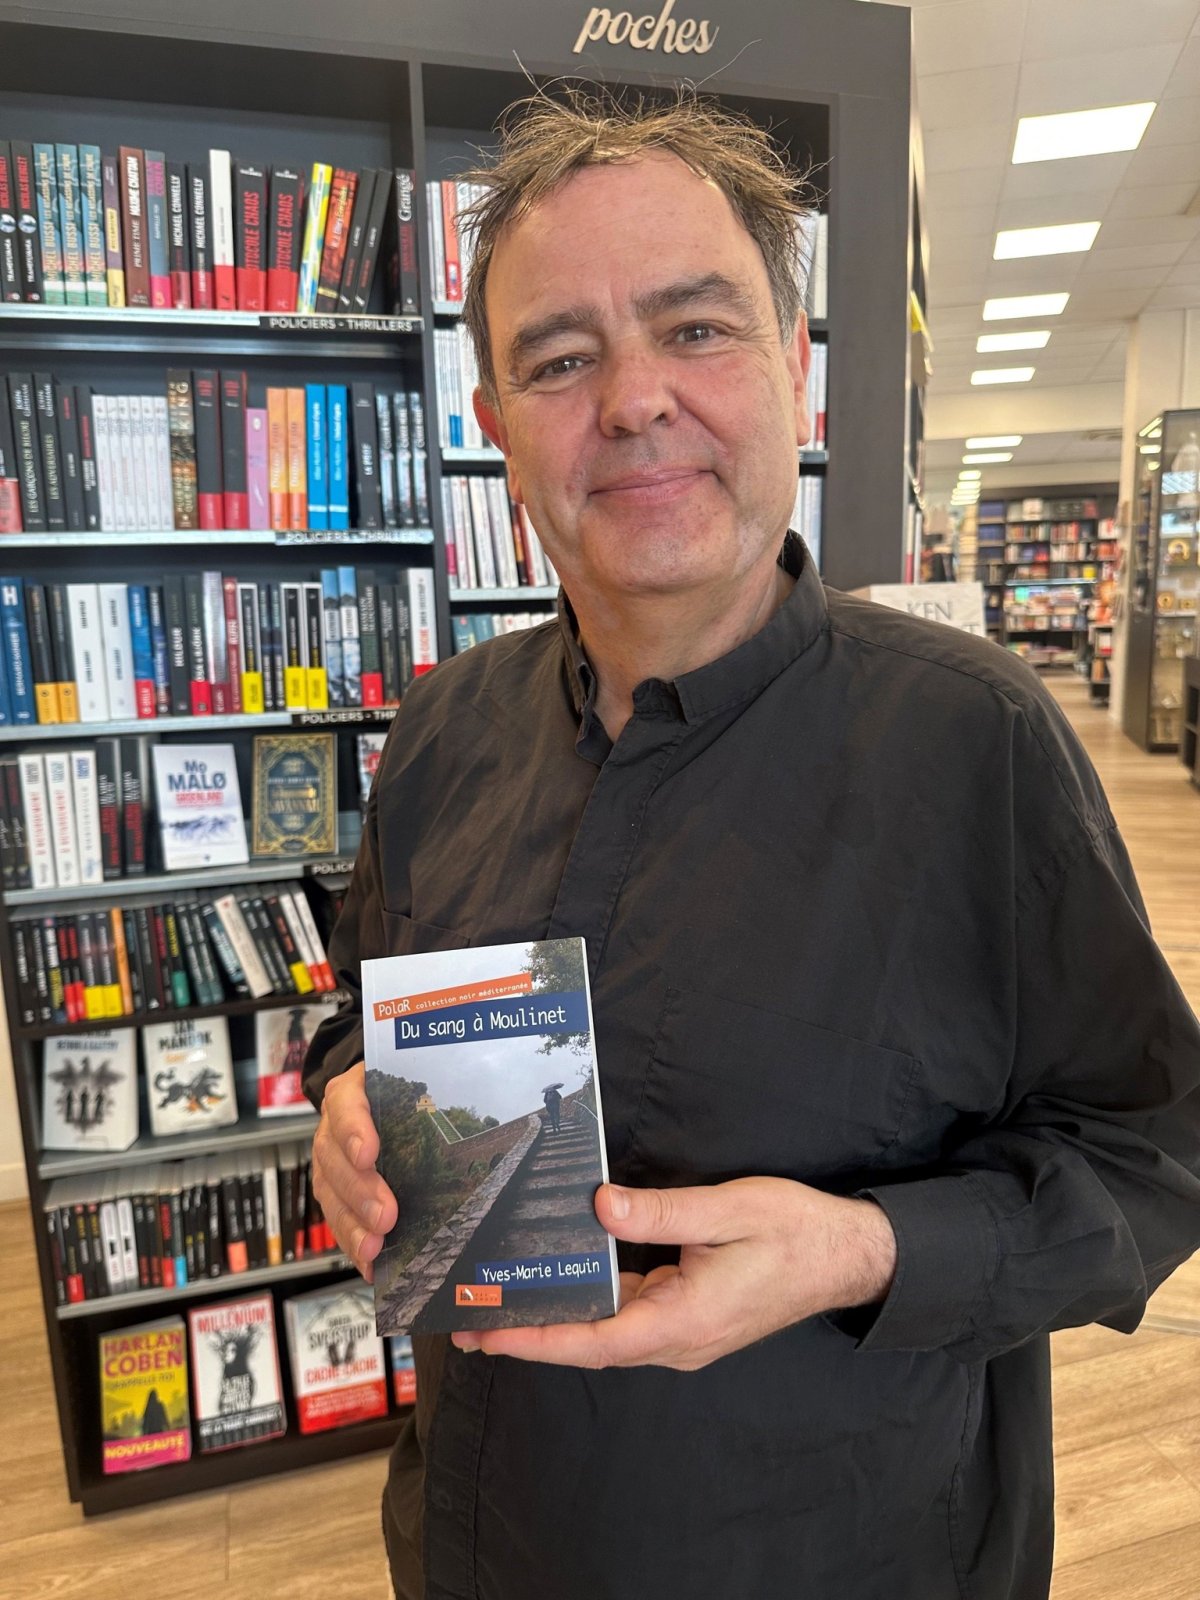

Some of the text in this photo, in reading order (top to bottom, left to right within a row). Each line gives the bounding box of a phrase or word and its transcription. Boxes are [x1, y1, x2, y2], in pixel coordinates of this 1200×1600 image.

[572, 0, 719, 54] poches
[127, 156, 140, 189] CHATTAM
[170, 175, 184, 246] MICHAEL CONNELLY
[193, 178, 205, 215] CONNELLY
[243, 191, 260, 225] CHAOS
[277, 193, 294, 227] CHAOS
[396, 173, 414, 222] Grangé
[131, 220, 142, 267] PRIME TIME
[195, 216, 206, 248] MICHAEL
[44, 222, 57, 282] MICHEL BUSSI
[65, 222, 78, 282] MICHEL BUSSI
[86, 222, 99, 282] MICHEL BUSSI
[269, 318, 337, 330] POLICIERS
[347, 319, 413, 333] THRILLERS
[176, 381, 190, 431] KING
[29, 500, 39, 513] LES
[171, 627, 184, 667] HILDUR
[301, 711, 363, 725] POLICIERS
[373, 710, 397, 721] THR
[168, 773, 227, 791] MALØ
[184, 761, 207, 772] Mo
[378, 982, 528, 1017] PolaR collection noir méditerranée
[401, 1006, 567, 1040] Du sang à Moulinet
[482, 1258, 600, 1283] Yves-Marie Lequin
[104, 1332, 182, 1355] HARLAN
[105, 1351, 182, 1378] COBEN
[104, 1434, 184, 1459] NOUVEAUTÉ
